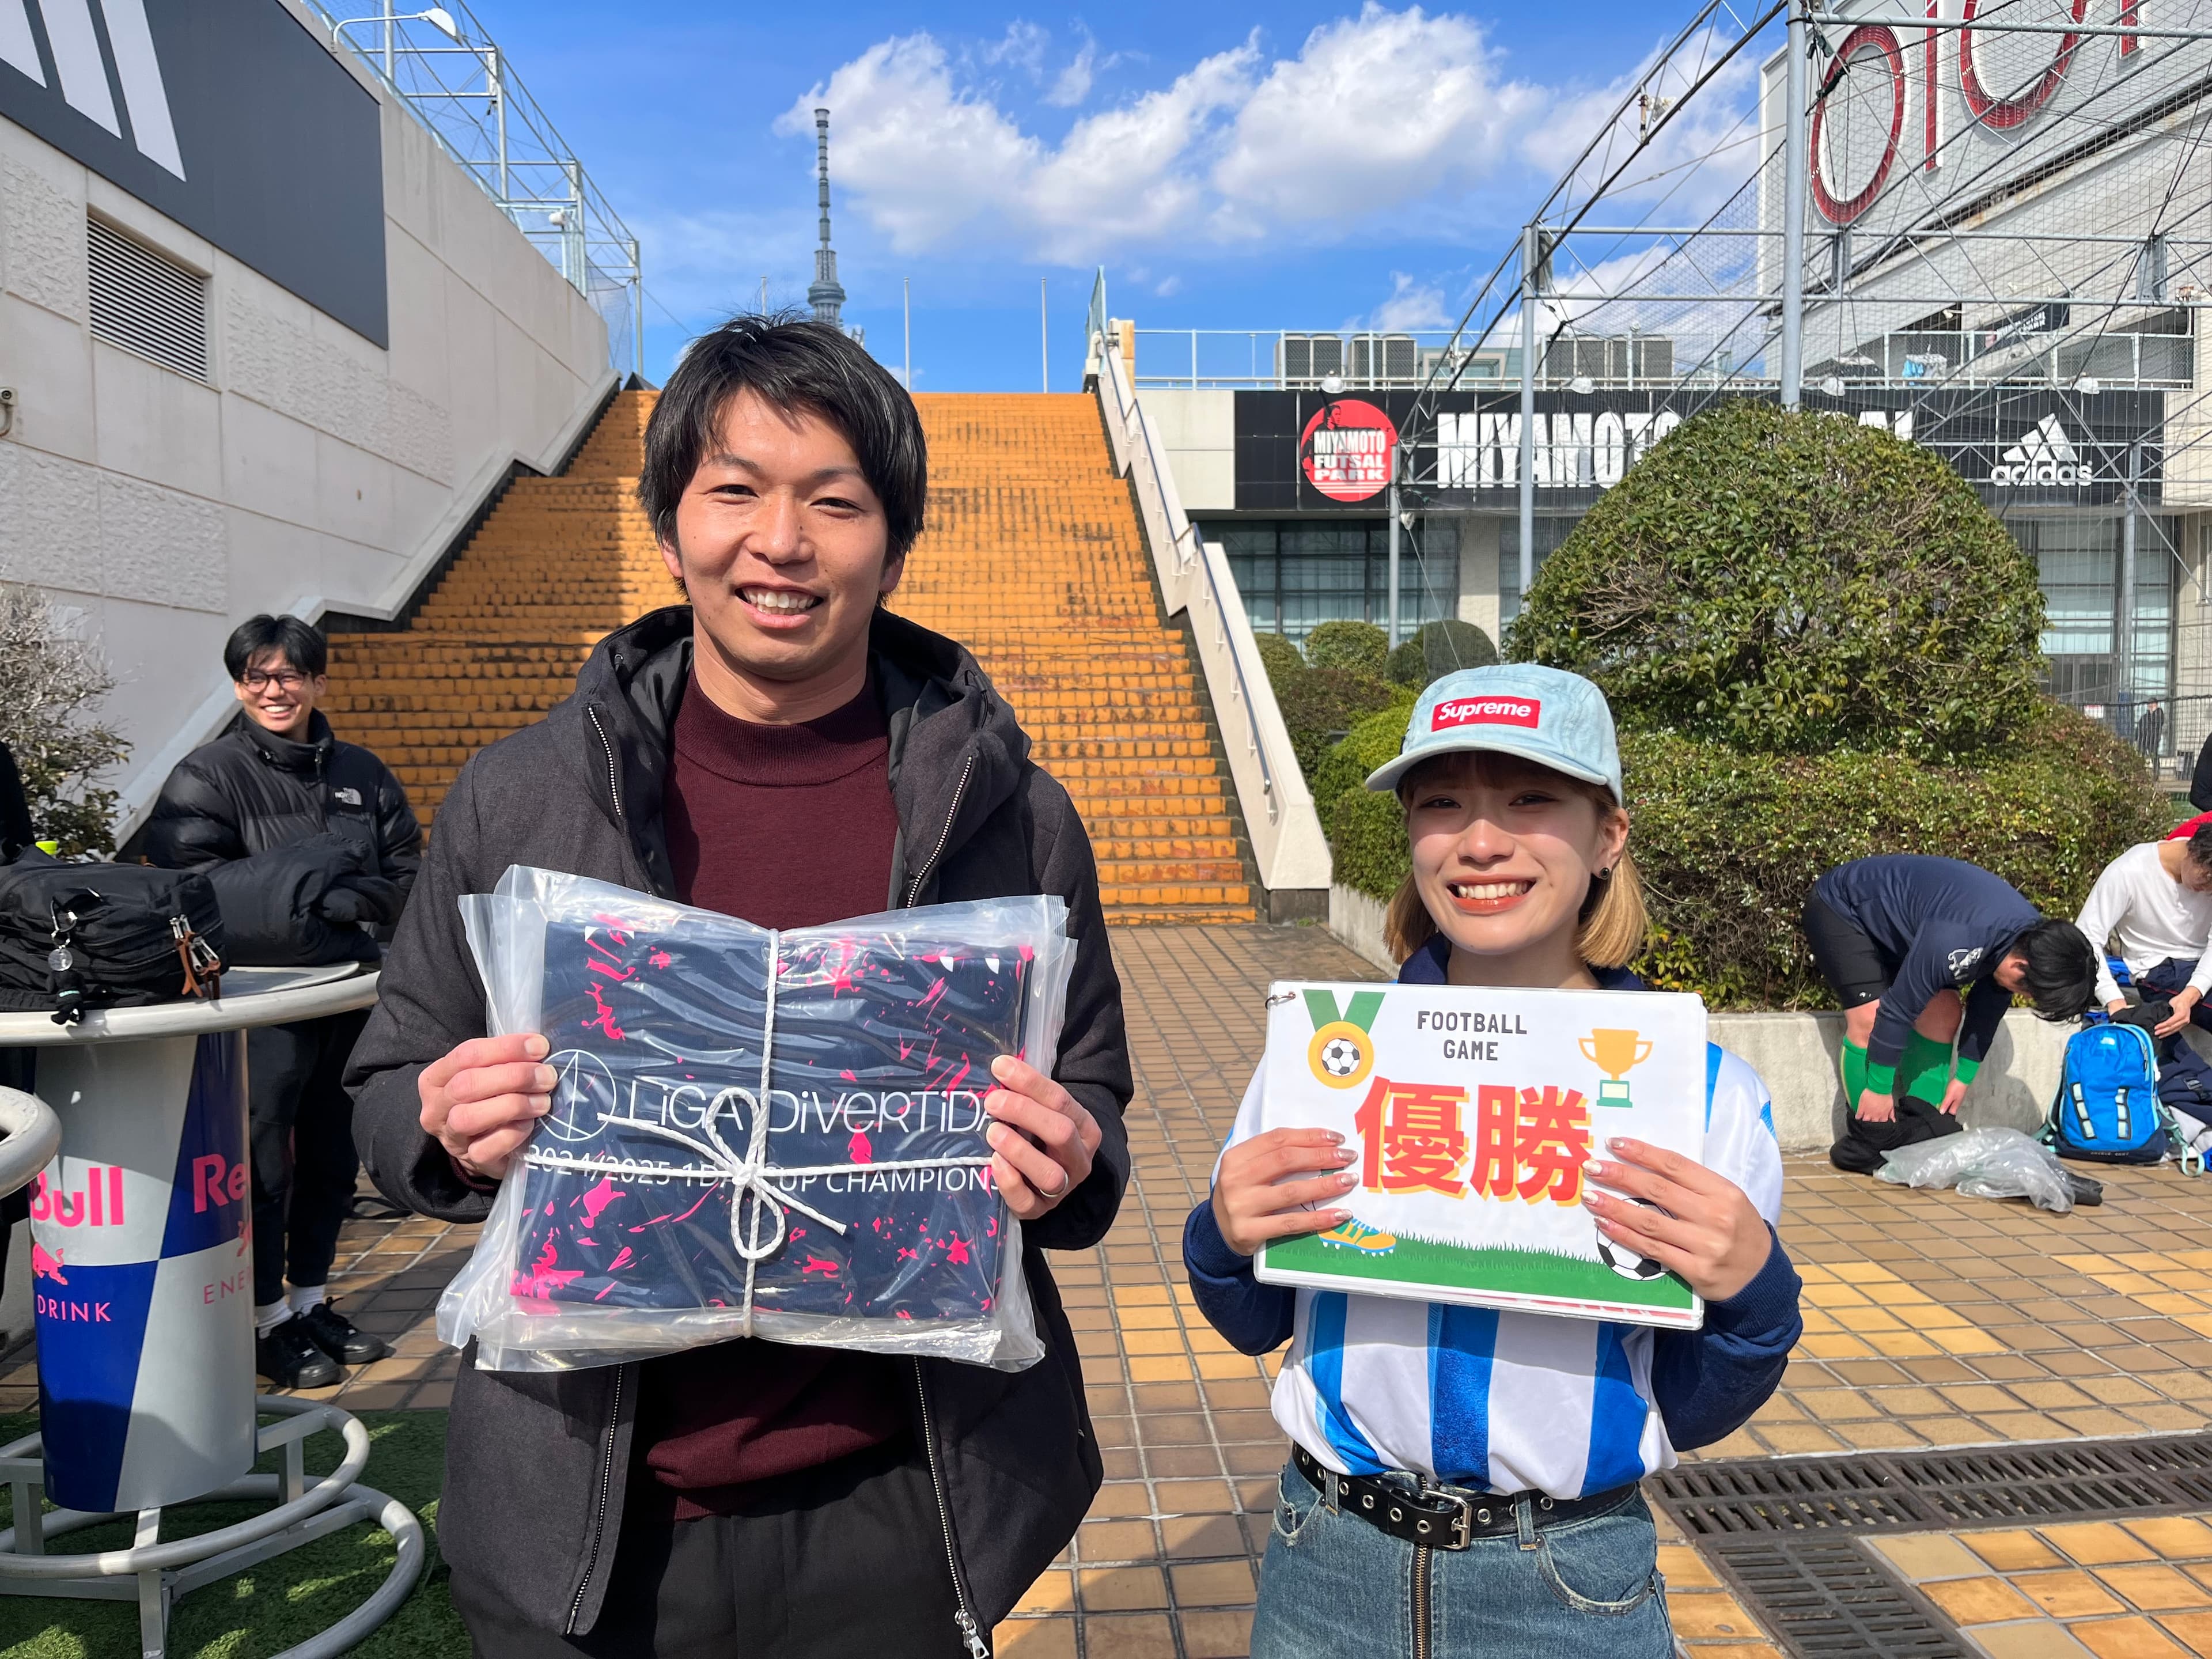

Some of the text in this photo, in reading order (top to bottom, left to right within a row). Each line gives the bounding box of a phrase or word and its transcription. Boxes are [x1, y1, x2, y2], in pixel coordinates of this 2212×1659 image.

[1313, 430, 1386, 454] MIYAMOTO
[1313, 454, 1385, 469] FUTSAL
[1990, 459, 2093, 487] adidas
[1314, 469, 1384, 480] PARK
[1437, 702, 1532, 722] Supreme
[1416, 1010, 1528, 1035] FOOTBALL
[1443, 1039, 1499, 1061] GAME
[1354, 1075, 1592, 1206] 優勝
[192, 1153, 248, 1214] Re
[766, 1165, 817, 1193] UP
[37, 1294, 112, 1323] DRINK
